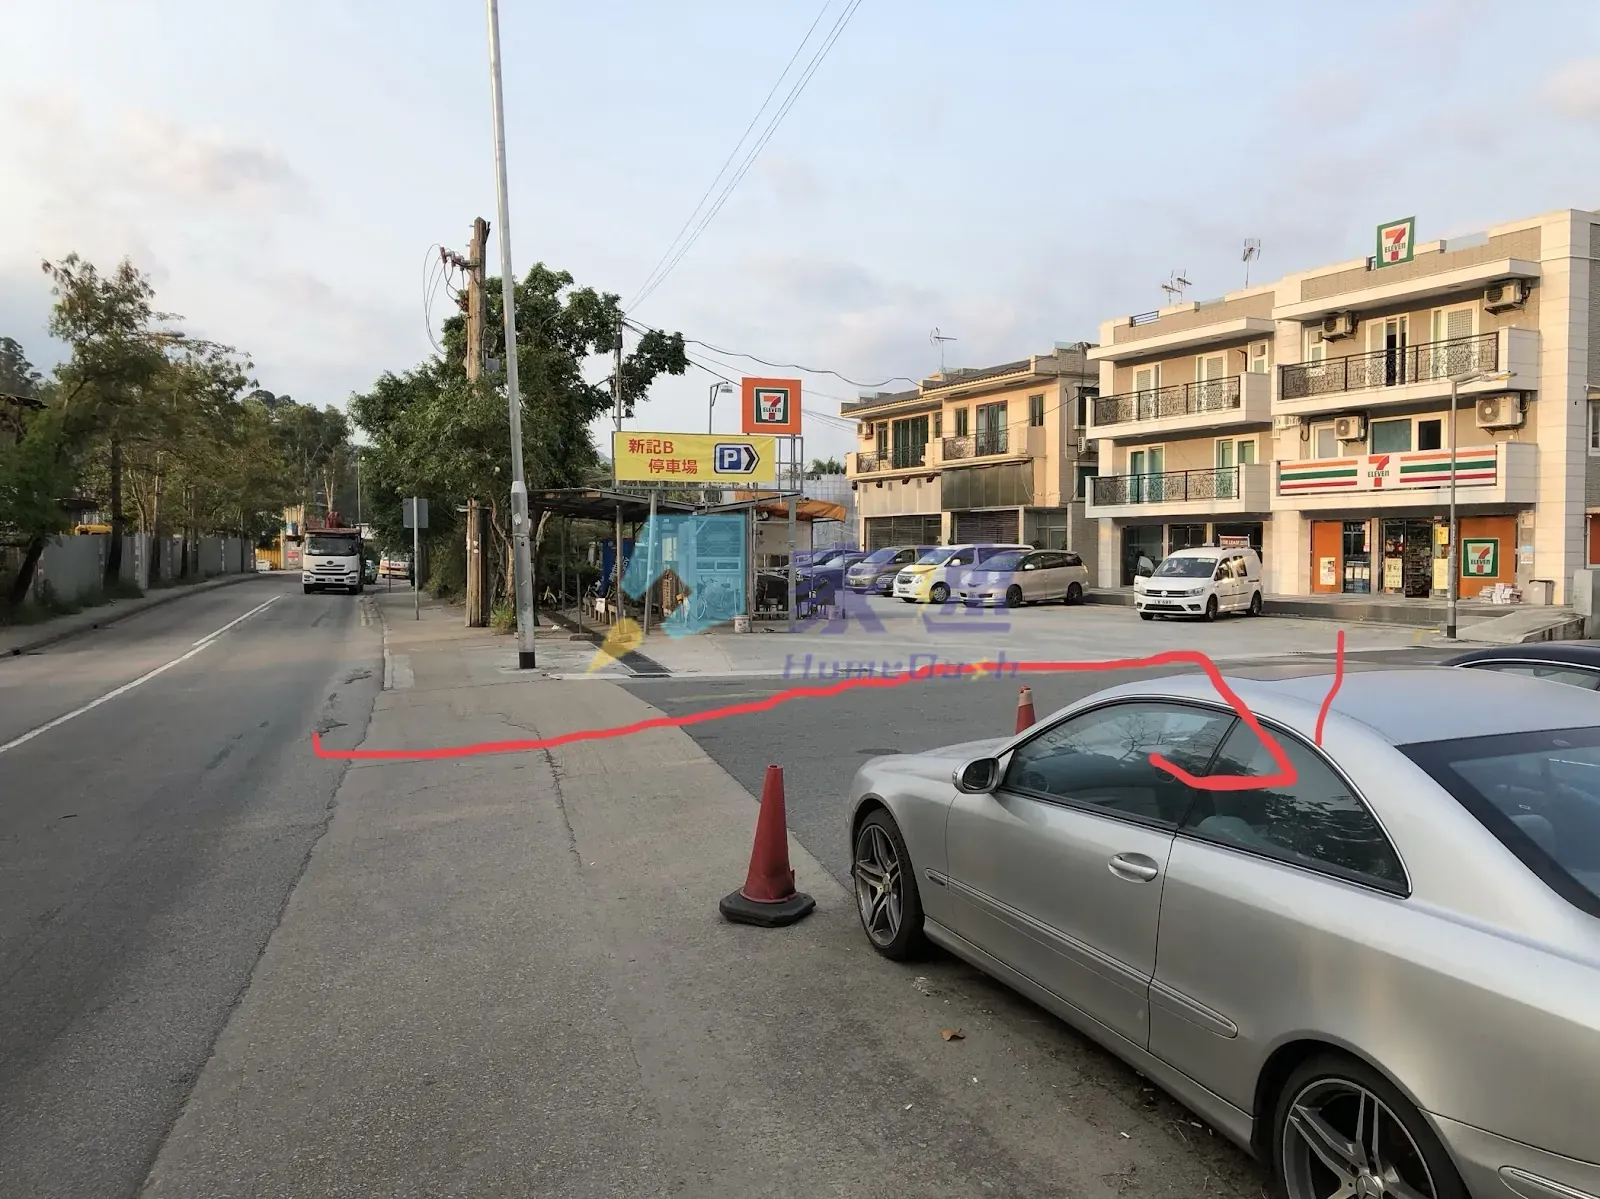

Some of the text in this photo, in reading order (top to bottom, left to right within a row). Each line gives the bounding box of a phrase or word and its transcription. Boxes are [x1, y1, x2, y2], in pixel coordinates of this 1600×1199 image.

[1385, 227, 1406, 261] 7
[763, 395, 782, 420] 7
[628, 438, 674, 455] 新記B
[723, 449, 738, 468] P
[648, 458, 698, 475] 停車場
[1368, 455, 1389, 487] 7
[1471, 546, 1490, 573] 7
